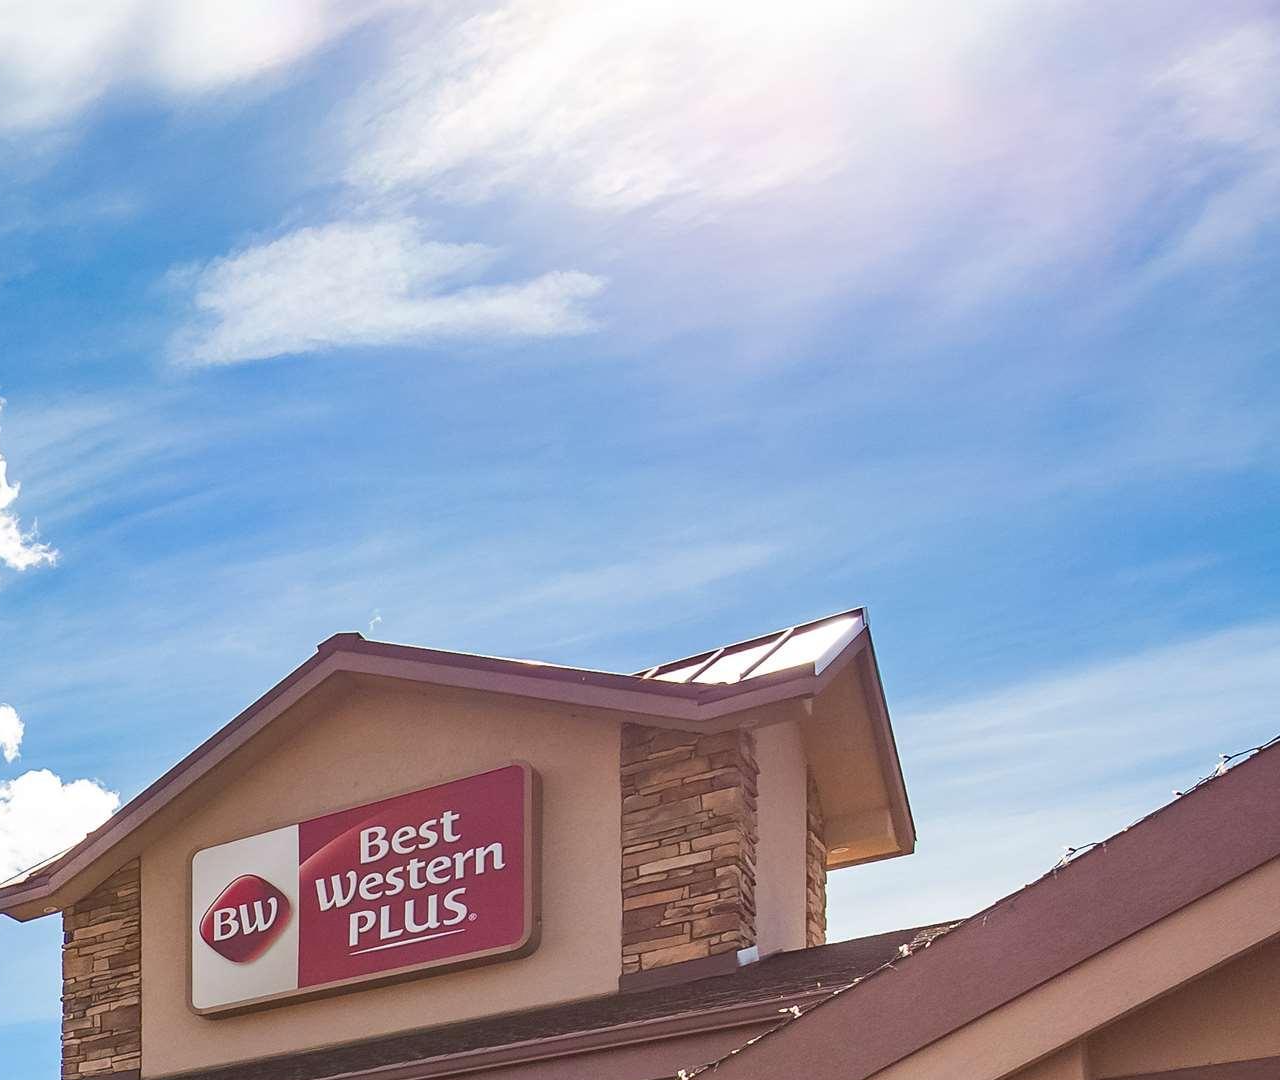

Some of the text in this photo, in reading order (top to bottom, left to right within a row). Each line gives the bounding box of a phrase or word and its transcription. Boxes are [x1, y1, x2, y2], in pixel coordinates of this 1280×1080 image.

[360, 810, 461, 865] Best
[315, 842, 506, 912] Western
[212, 896, 278, 942] BW
[348, 887, 469, 947] PLUS
